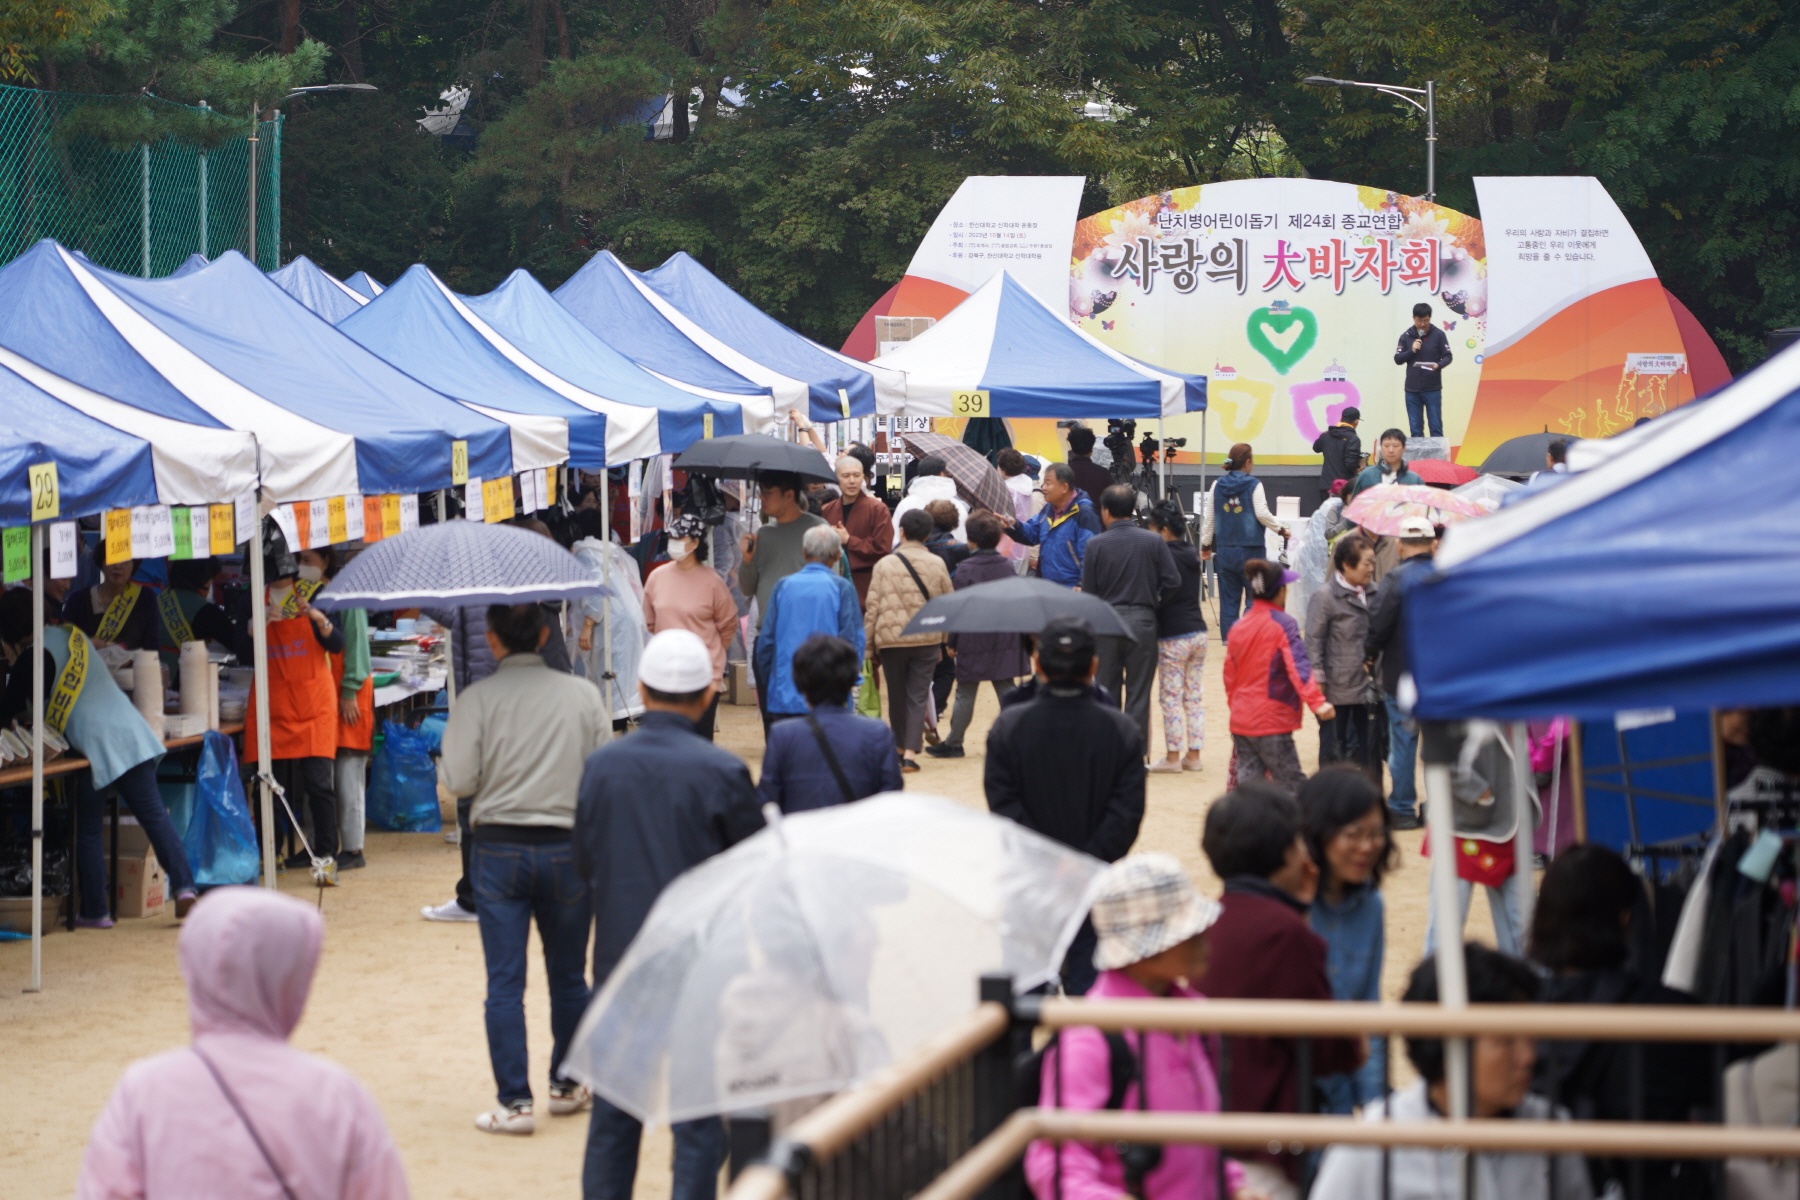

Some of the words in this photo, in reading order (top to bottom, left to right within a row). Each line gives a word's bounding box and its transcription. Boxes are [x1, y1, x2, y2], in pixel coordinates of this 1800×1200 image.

[1158, 213, 1279, 230] 난치병어린이돕기
[1288, 213, 1336, 230] 제24회
[1341, 213, 1403, 231] 종교연합
[1504, 229, 1527, 238] 우리의
[1530, 229, 1552, 238] 사랑과
[1555, 229, 1577, 238] 자비가
[1580, 229, 1609, 238] 결집하면
[1517, 241, 1547, 250] 고통중인
[1549, 241, 1564, 250] 우리
[1567, 241, 1597, 250] 이웃에게
[1015, 252, 1042, 260] 신학대학원
[1518, 253, 1540, 261] 희망을
[1543, 253, 1551, 261] 줄
[1564, 253, 1596, 261] 있습니다.
[1112, 237, 1246, 294] 사랑의
[958, 394, 983, 413] 39
[36, 472, 54, 511] 29
